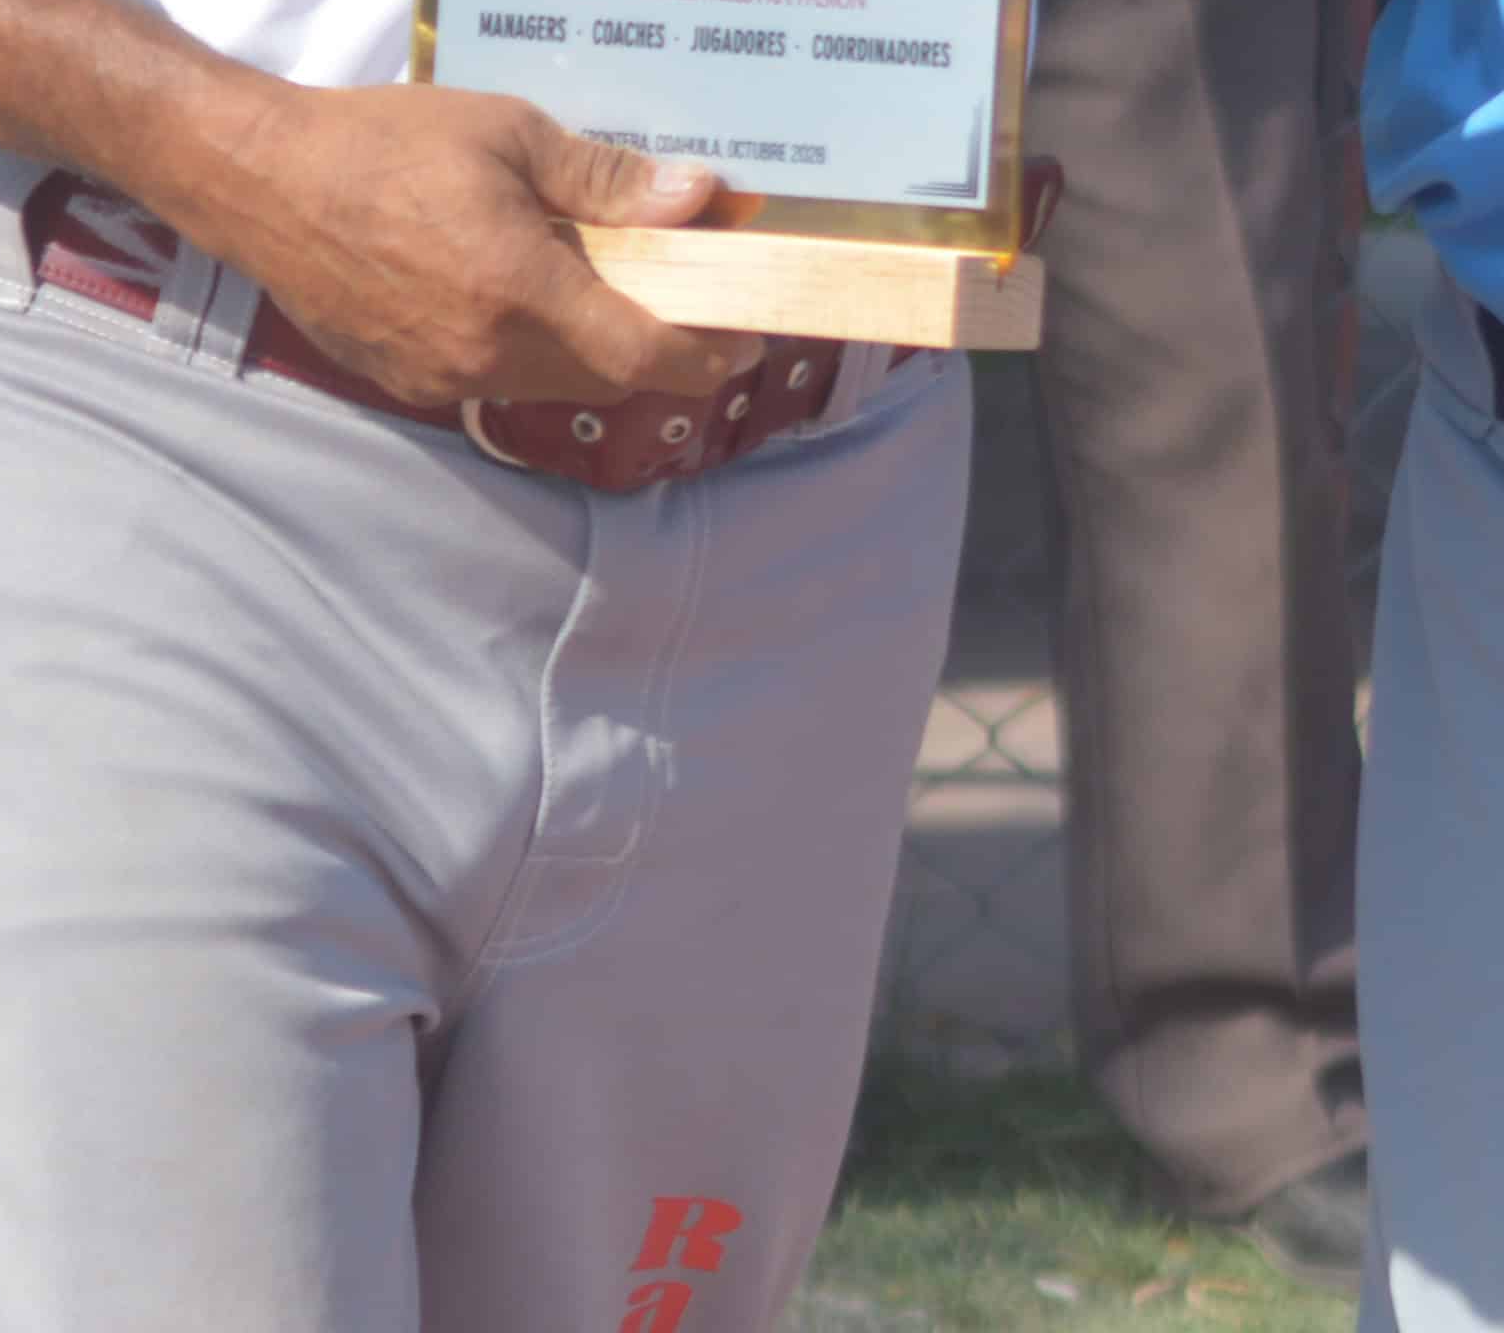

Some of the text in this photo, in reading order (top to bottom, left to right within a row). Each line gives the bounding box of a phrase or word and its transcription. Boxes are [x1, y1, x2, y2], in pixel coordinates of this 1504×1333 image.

[479, 11, 952, 68] MANAGERS COACHES JUGADORES COORDINADORES
[727, 139, 786, 162] OCTUBRE
